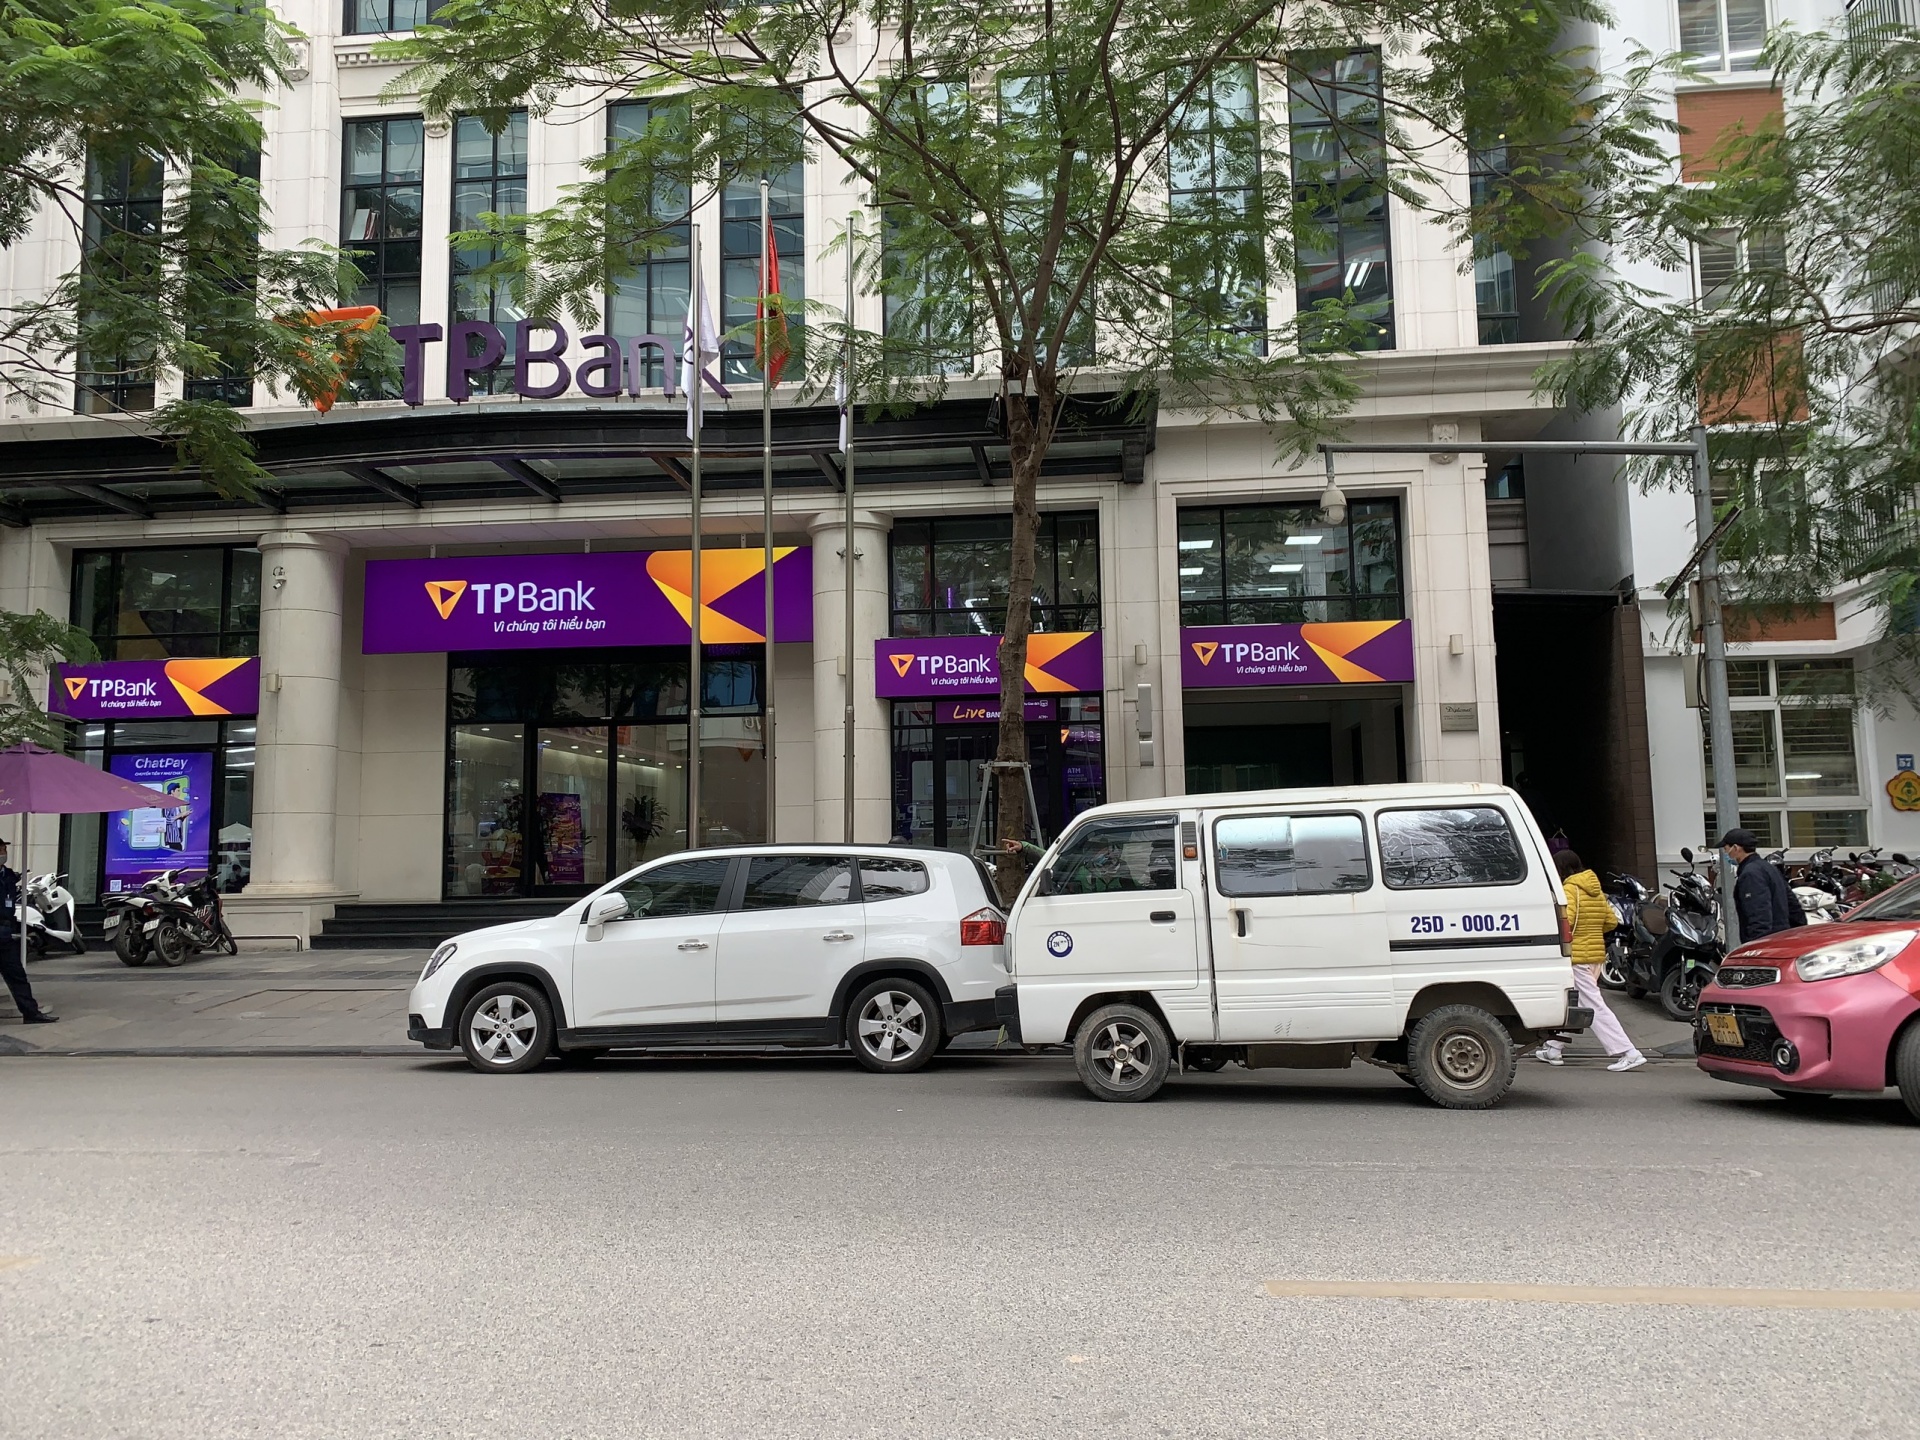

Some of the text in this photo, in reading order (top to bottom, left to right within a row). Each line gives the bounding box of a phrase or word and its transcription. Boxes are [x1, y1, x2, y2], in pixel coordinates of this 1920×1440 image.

[471, 580, 596, 614] TPBank
[494, 616, 606, 633] Vì chúng tôi hiểu bạn
[1221, 641, 1301, 663] TPBank
[916, 653, 991, 675] TPBank
[1244, 665, 1266, 674] chúng
[1267, 664, 1277, 673] tôi
[1277, 662, 1293, 672] hiểu
[1294, 664, 1308, 673] bạn
[89, 678, 157, 697] TPBank
[938, 677, 959, 686] chúng
[960, 676, 969, 685] tôi
[985, 676, 998, 685] bạn
[107, 700, 126, 709] chúng
[953, 705, 1001, 719] Live BAN
[135, 757, 188, 771] ChatPay
[1410, 915, 1445, 933] 25D
[1461, 914, 1520, 932] 000.21
